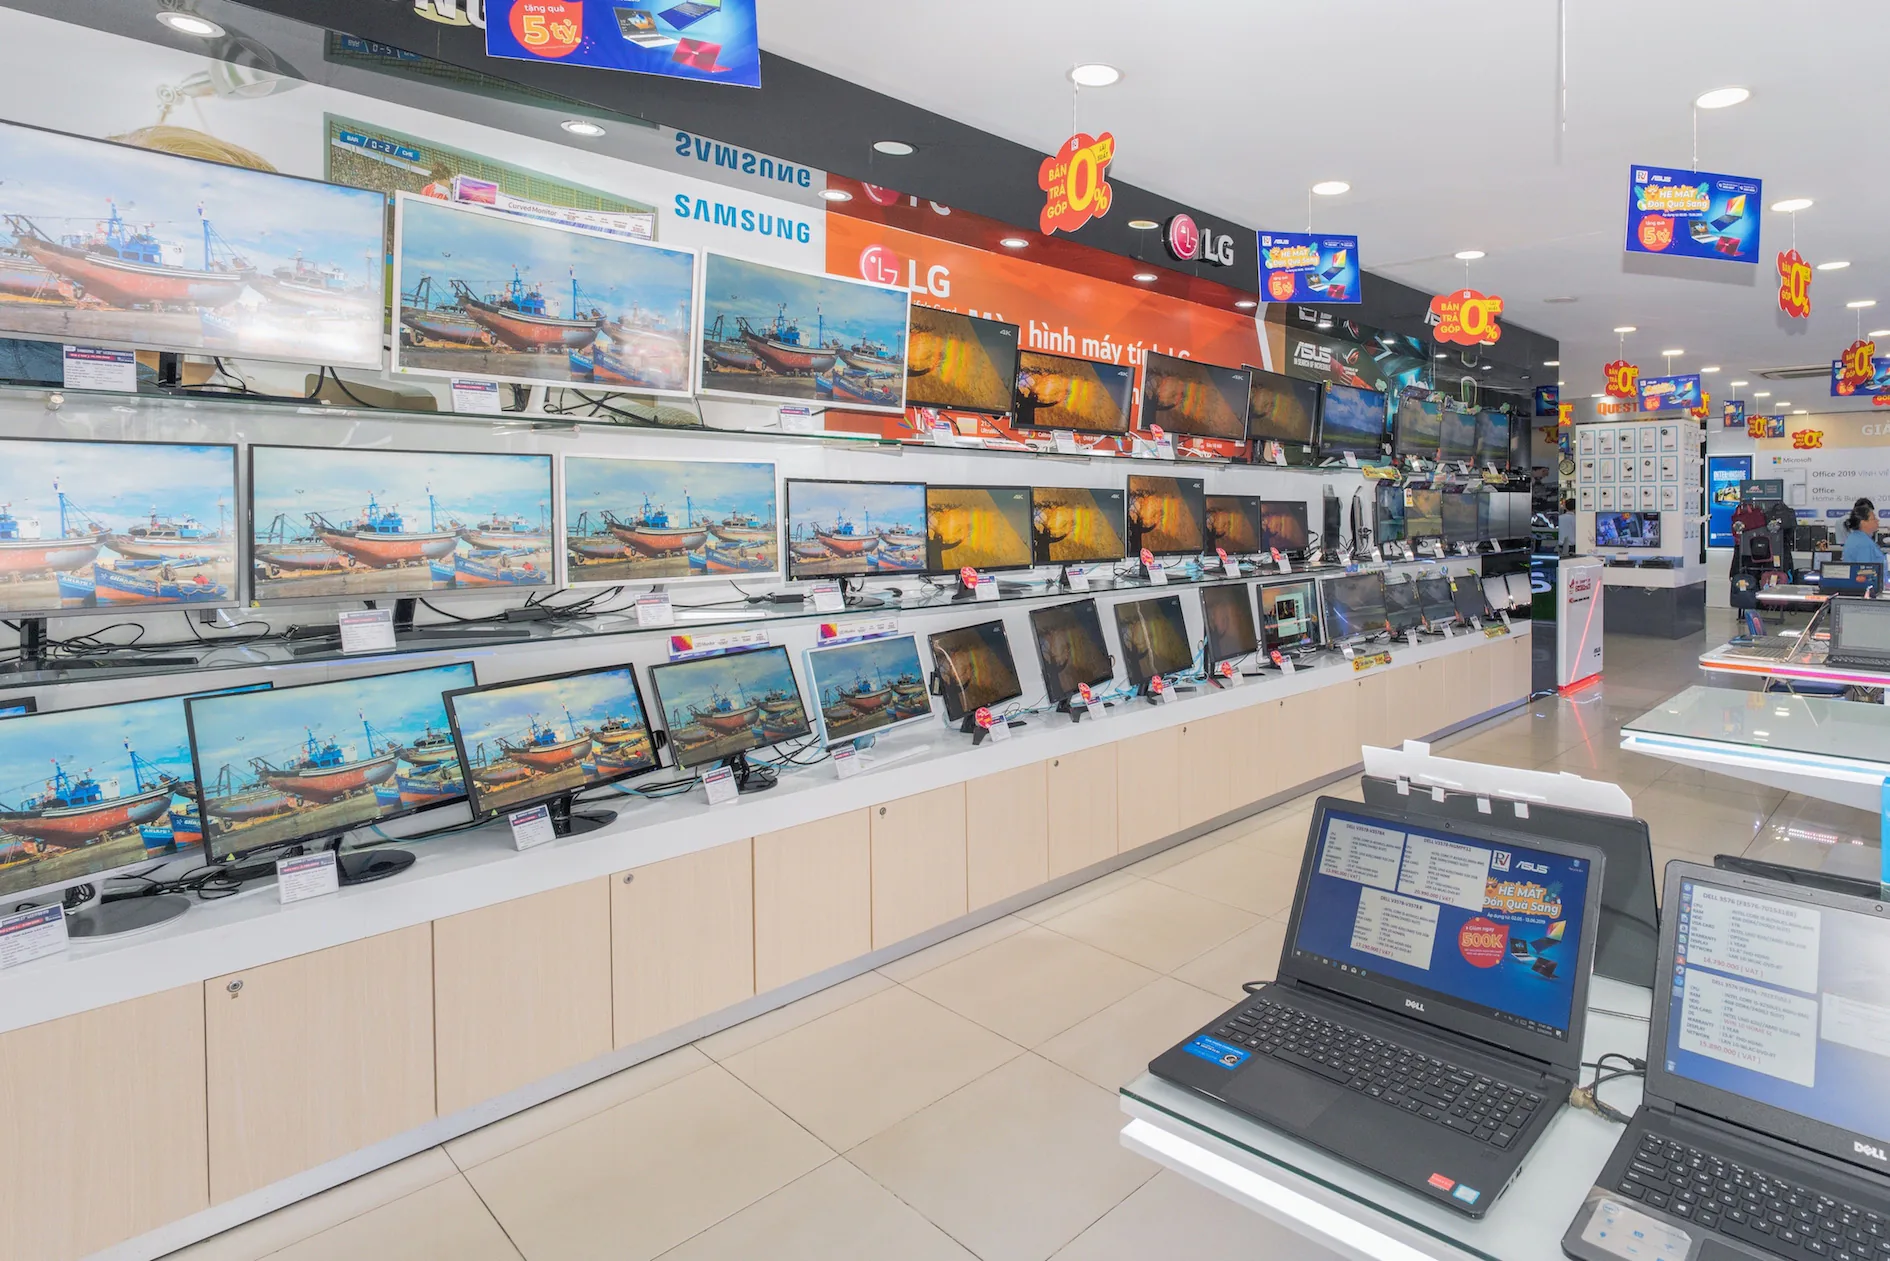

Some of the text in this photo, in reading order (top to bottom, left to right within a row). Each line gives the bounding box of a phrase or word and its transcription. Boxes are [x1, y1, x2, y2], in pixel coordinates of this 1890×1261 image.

[524, 4, 565, 14] tặng quà
[523, 15, 550, 45] 5
[346, 135, 359, 143] BAR
[402, 149, 414, 158] CHE
[1048, 163, 1067, 182] BÁN
[1650, 175, 1672, 183] ASUS
[1049, 179, 1066, 199] TRẢ
[508, 201, 558, 217] Curved Monitor
[1047, 200, 1068, 219] GÓP
[1686, 200, 1708, 210] Sang
[674, 193, 811, 244] SAMSUNG
[1643, 226, 1657, 245] 5
[1205, 228, 1234, 266] LG
[908, 259, 950, 298] LG
[1272, 281, 1284, 296] 5
[1441, 302, 1460, 311] BÁN
[1442, 312, 1459, 323] TRẢ
[1000, 329, 1012, 337] 4K
[1440, 323, 1460, 334] GÓP
[1029, 320, 1076, 355] hình
[1082, 334, 1123, 365] máy
[1294, 341, 1332, 365] ASUS
[1812, 470, 1835, 478] Office
[1515, 861, 1550, 874] ASUS
[1498, 882, 1544, 899] HÈ MÁT
[1703, 892, 1718, 901] DELL
[1506, 899, 1528, 912] Quà
[1530, 902, 1558, 915] Sang
[1461, 931, 1504, 949] 500K
[1690, 938, 1708, 946] DISPLAY
[1691, 932, 1717, 942] WARRANTY
[1690, 944, 1713, 953] NETWORK
[1405, 999, 1425, 1012] DELL
[1687, 1022, 1706, 1031] DISPLAY
[1688, 1017, 1714, 1027] WARRANTY
[1686, 1028, 1710, 1039] NETWORK
[1854, 1141, 1887, 1162] DELL
